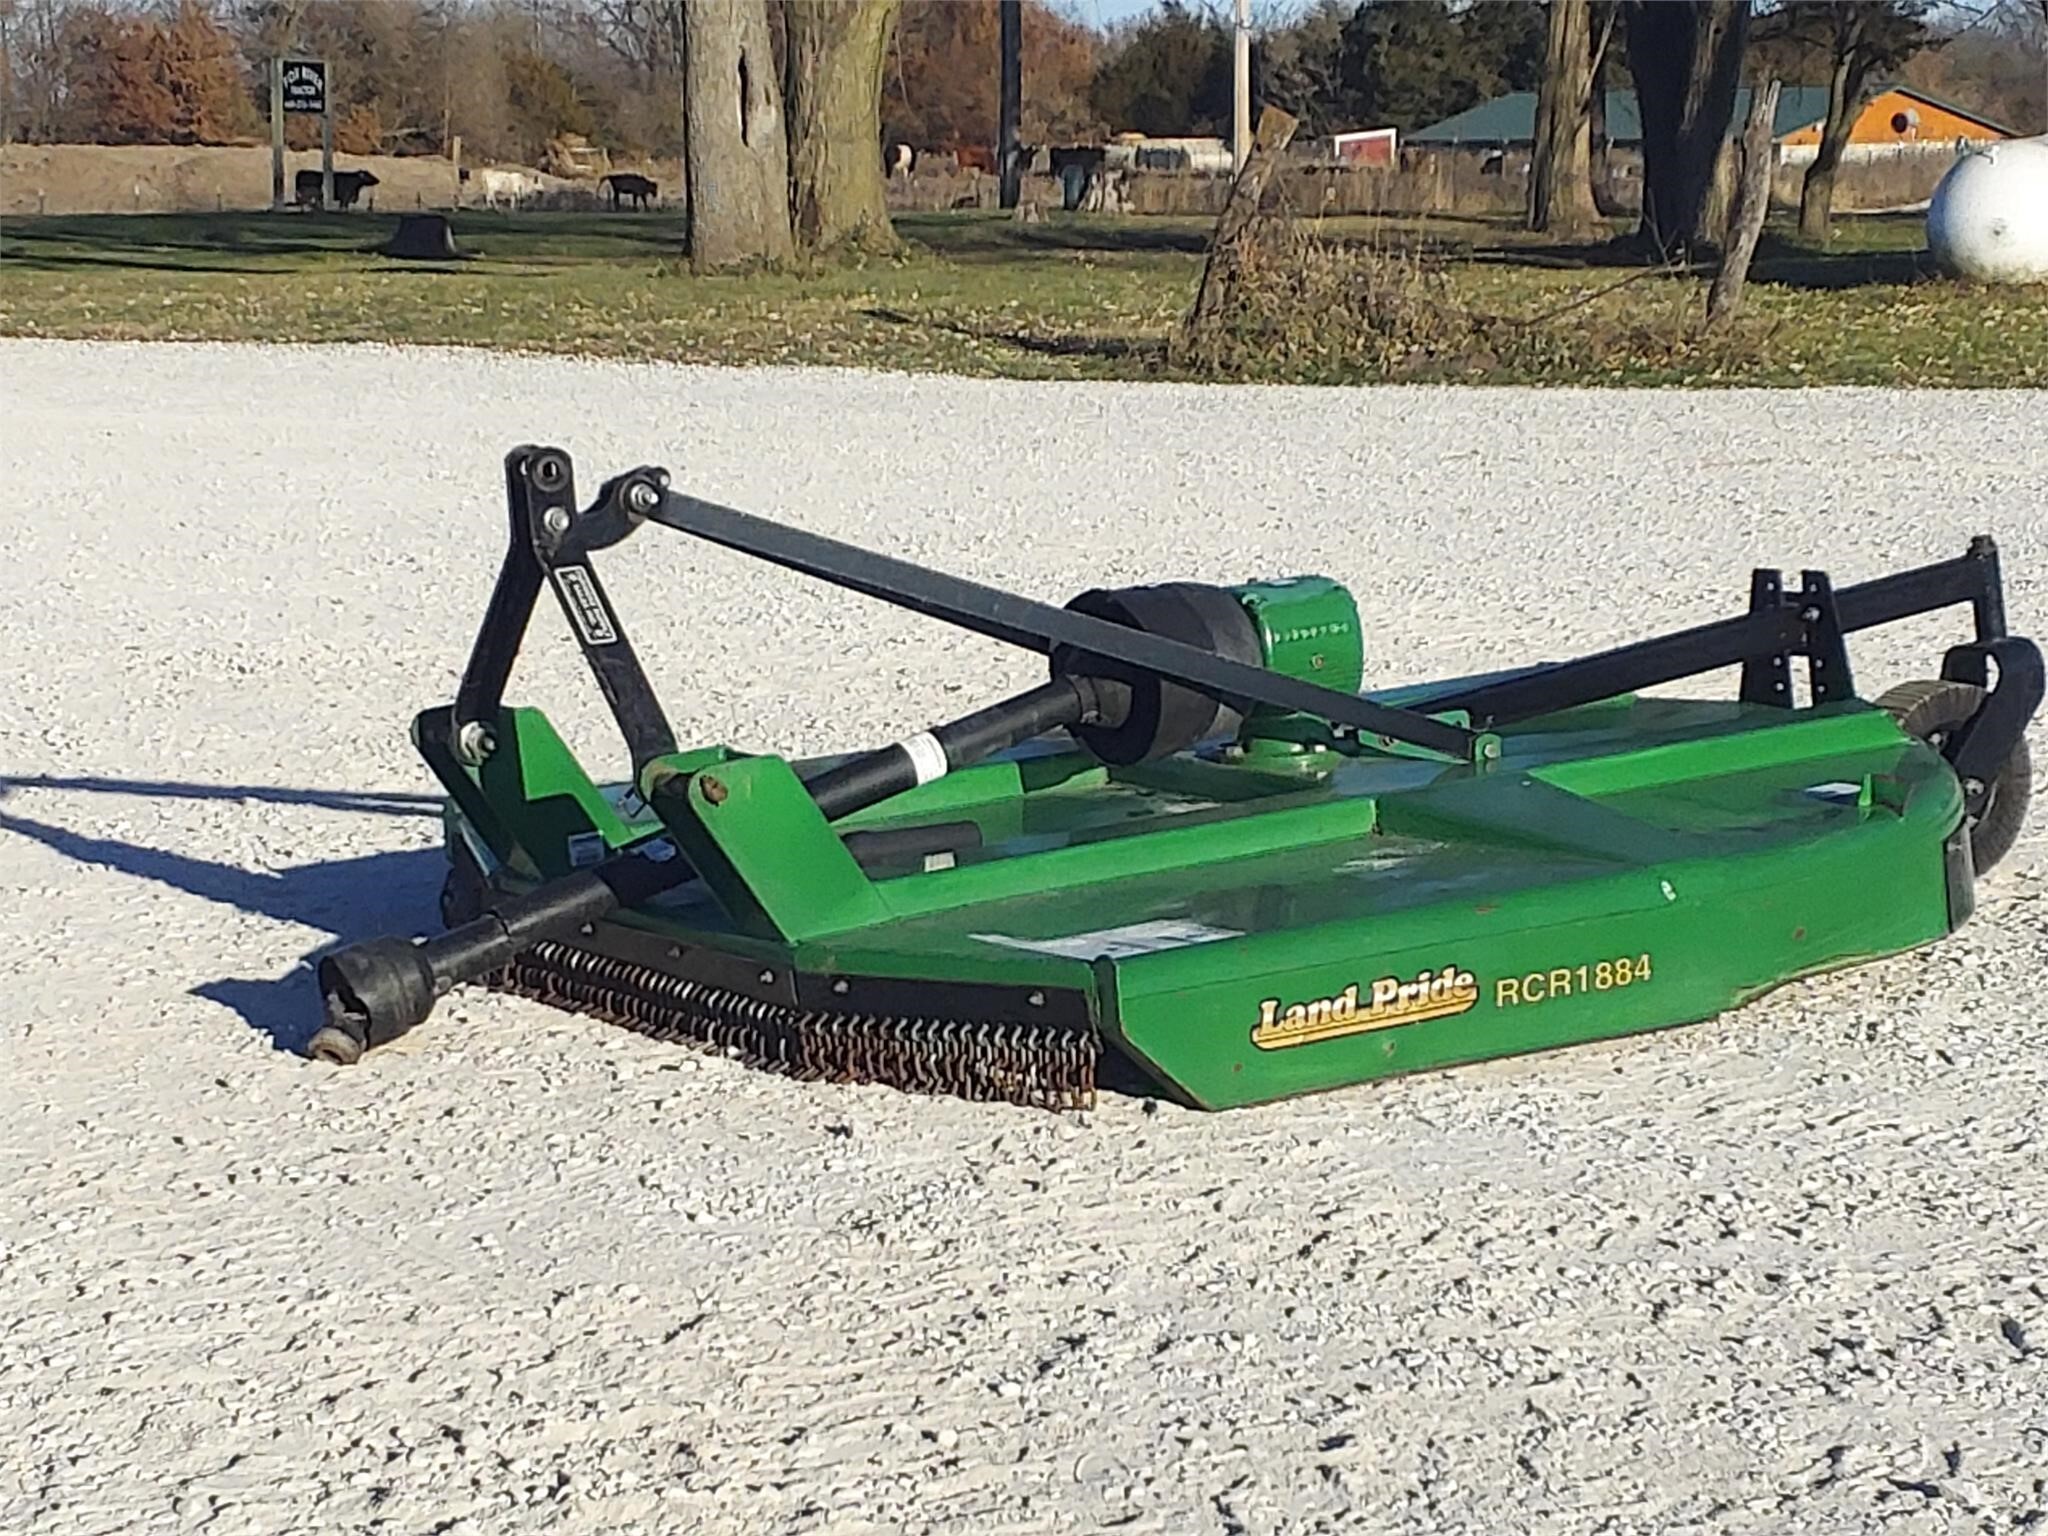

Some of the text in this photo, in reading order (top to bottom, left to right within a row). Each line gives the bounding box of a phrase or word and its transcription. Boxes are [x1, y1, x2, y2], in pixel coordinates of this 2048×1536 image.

[1257, 966, 1475, 1037] Land Pride
[1496, 953, 1652, 1008] RCR1884
